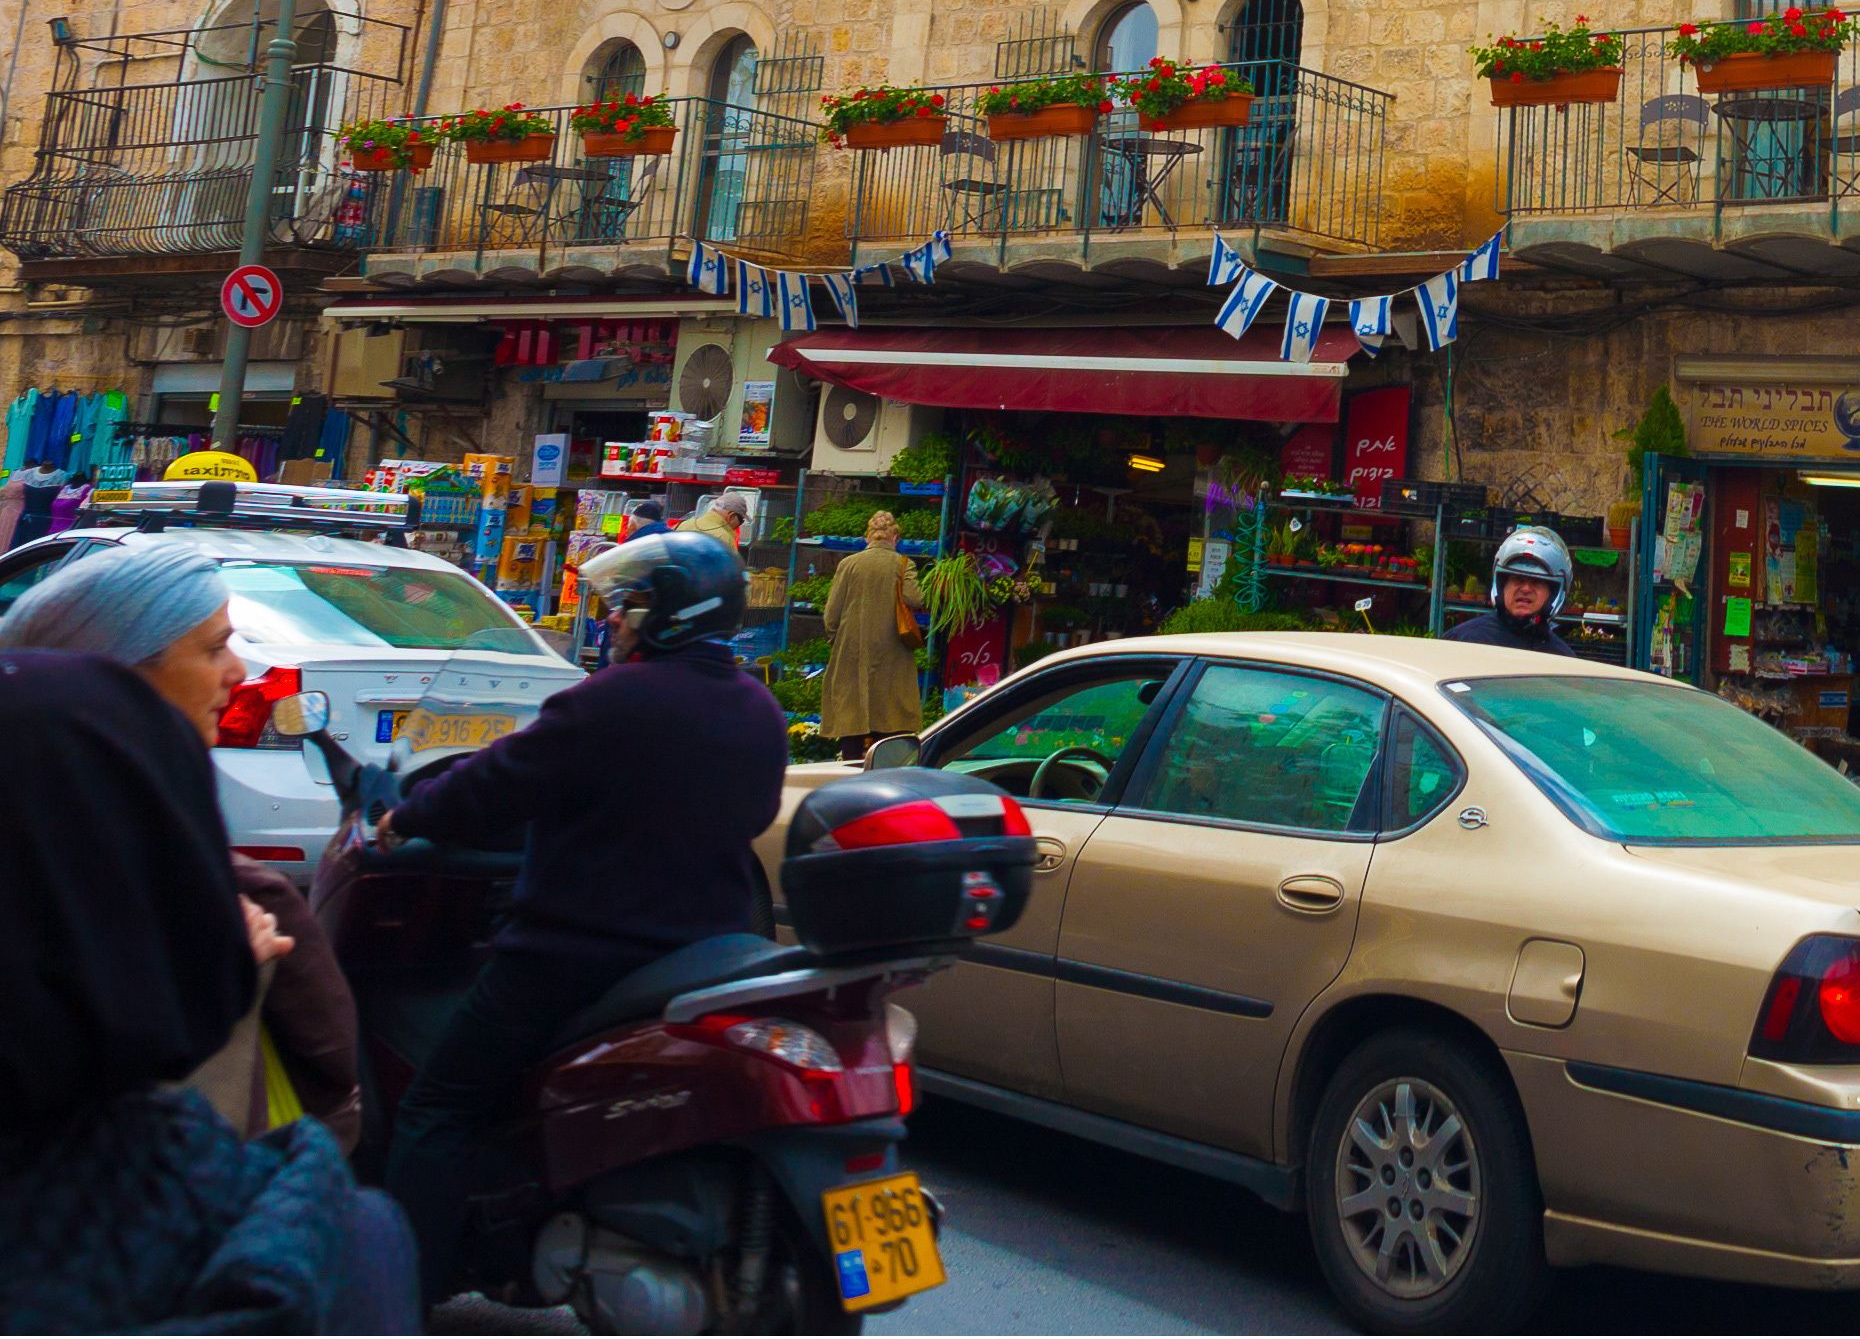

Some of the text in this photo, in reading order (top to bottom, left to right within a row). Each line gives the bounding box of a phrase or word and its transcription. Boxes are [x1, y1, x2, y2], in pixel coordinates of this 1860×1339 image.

[1753, 387, 1833, 412] תבליני
[1700, 416, 1829, 433] THE WORLD SPICES
[184, 463, 218, 476] taxi
[383, 674, 529, 690] VOLVO
[834, 1188, 920, 1245] 61-966
[880, 1237, 917, 1284] 70
